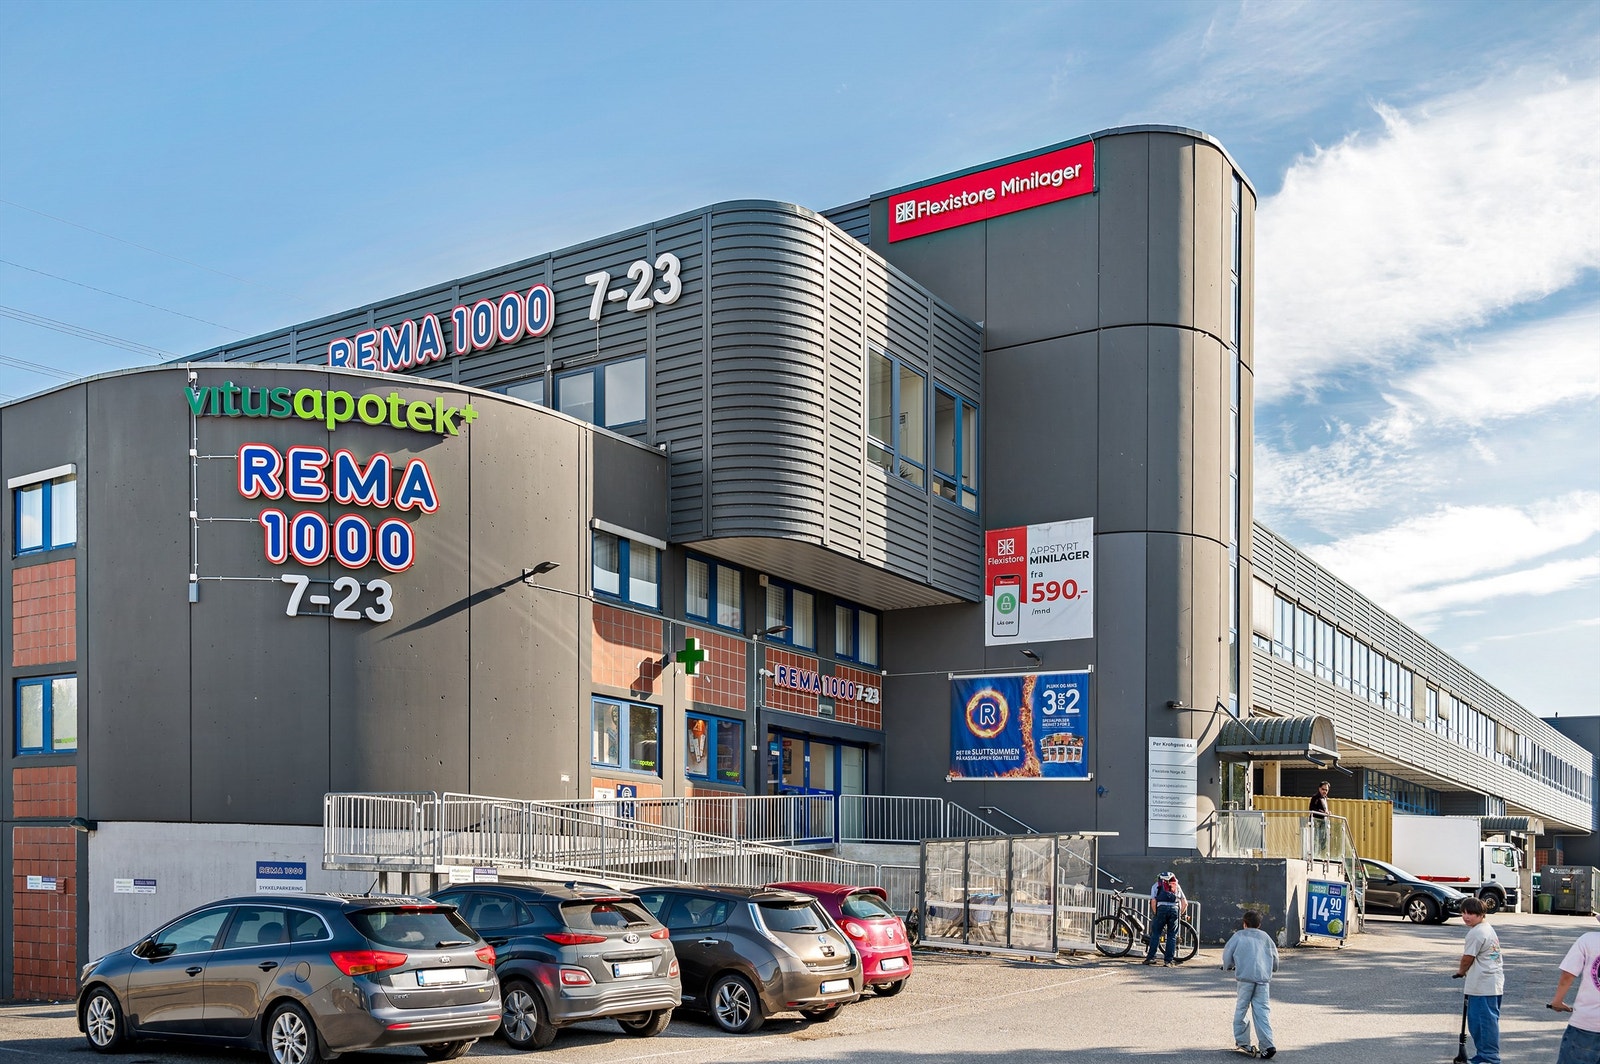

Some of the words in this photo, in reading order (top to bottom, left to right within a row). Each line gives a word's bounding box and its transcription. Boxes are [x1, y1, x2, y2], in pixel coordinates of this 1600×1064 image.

[917, 186, 996, 219] Flexistore
[1001, 162, 1083, 198] Minilager
[328, 312, 447, 373] REMA
[451, 283, 555, 356] 1000
[585, 252, 683, 322] 7-23
[237, 442, 441, 514] REMA
[258, 508, 416, 573] 1000
[1030, 541, 1079, 556] APPSTYRT
[987, 555, 1025, 566] Flexistore
[1029, 550, 1090, 565] MINILAGER
[281, 574, 394, 623] 7-23
[1031, 578, 1089, 603] 590,-
[1031, 607, 1051, 616] /mnd
[775, 663, 822, 694] REMA
[821, 674, 856, 701] 1000
[980, 703, 996, 725] R
[1042, 689, 1057, 716] 3
[1057, 692, 1066, 710] FOR
[1065, 688, 1080, 714] 2
[971, 747, 1020, 756] SLUTTSUMMEN
[259, 866, 283, 875] REMA
[284, 866, 304, 876] 1000
[1311, 895, 1330, 922] 14
[1330, 897, 1342, 911] 90
